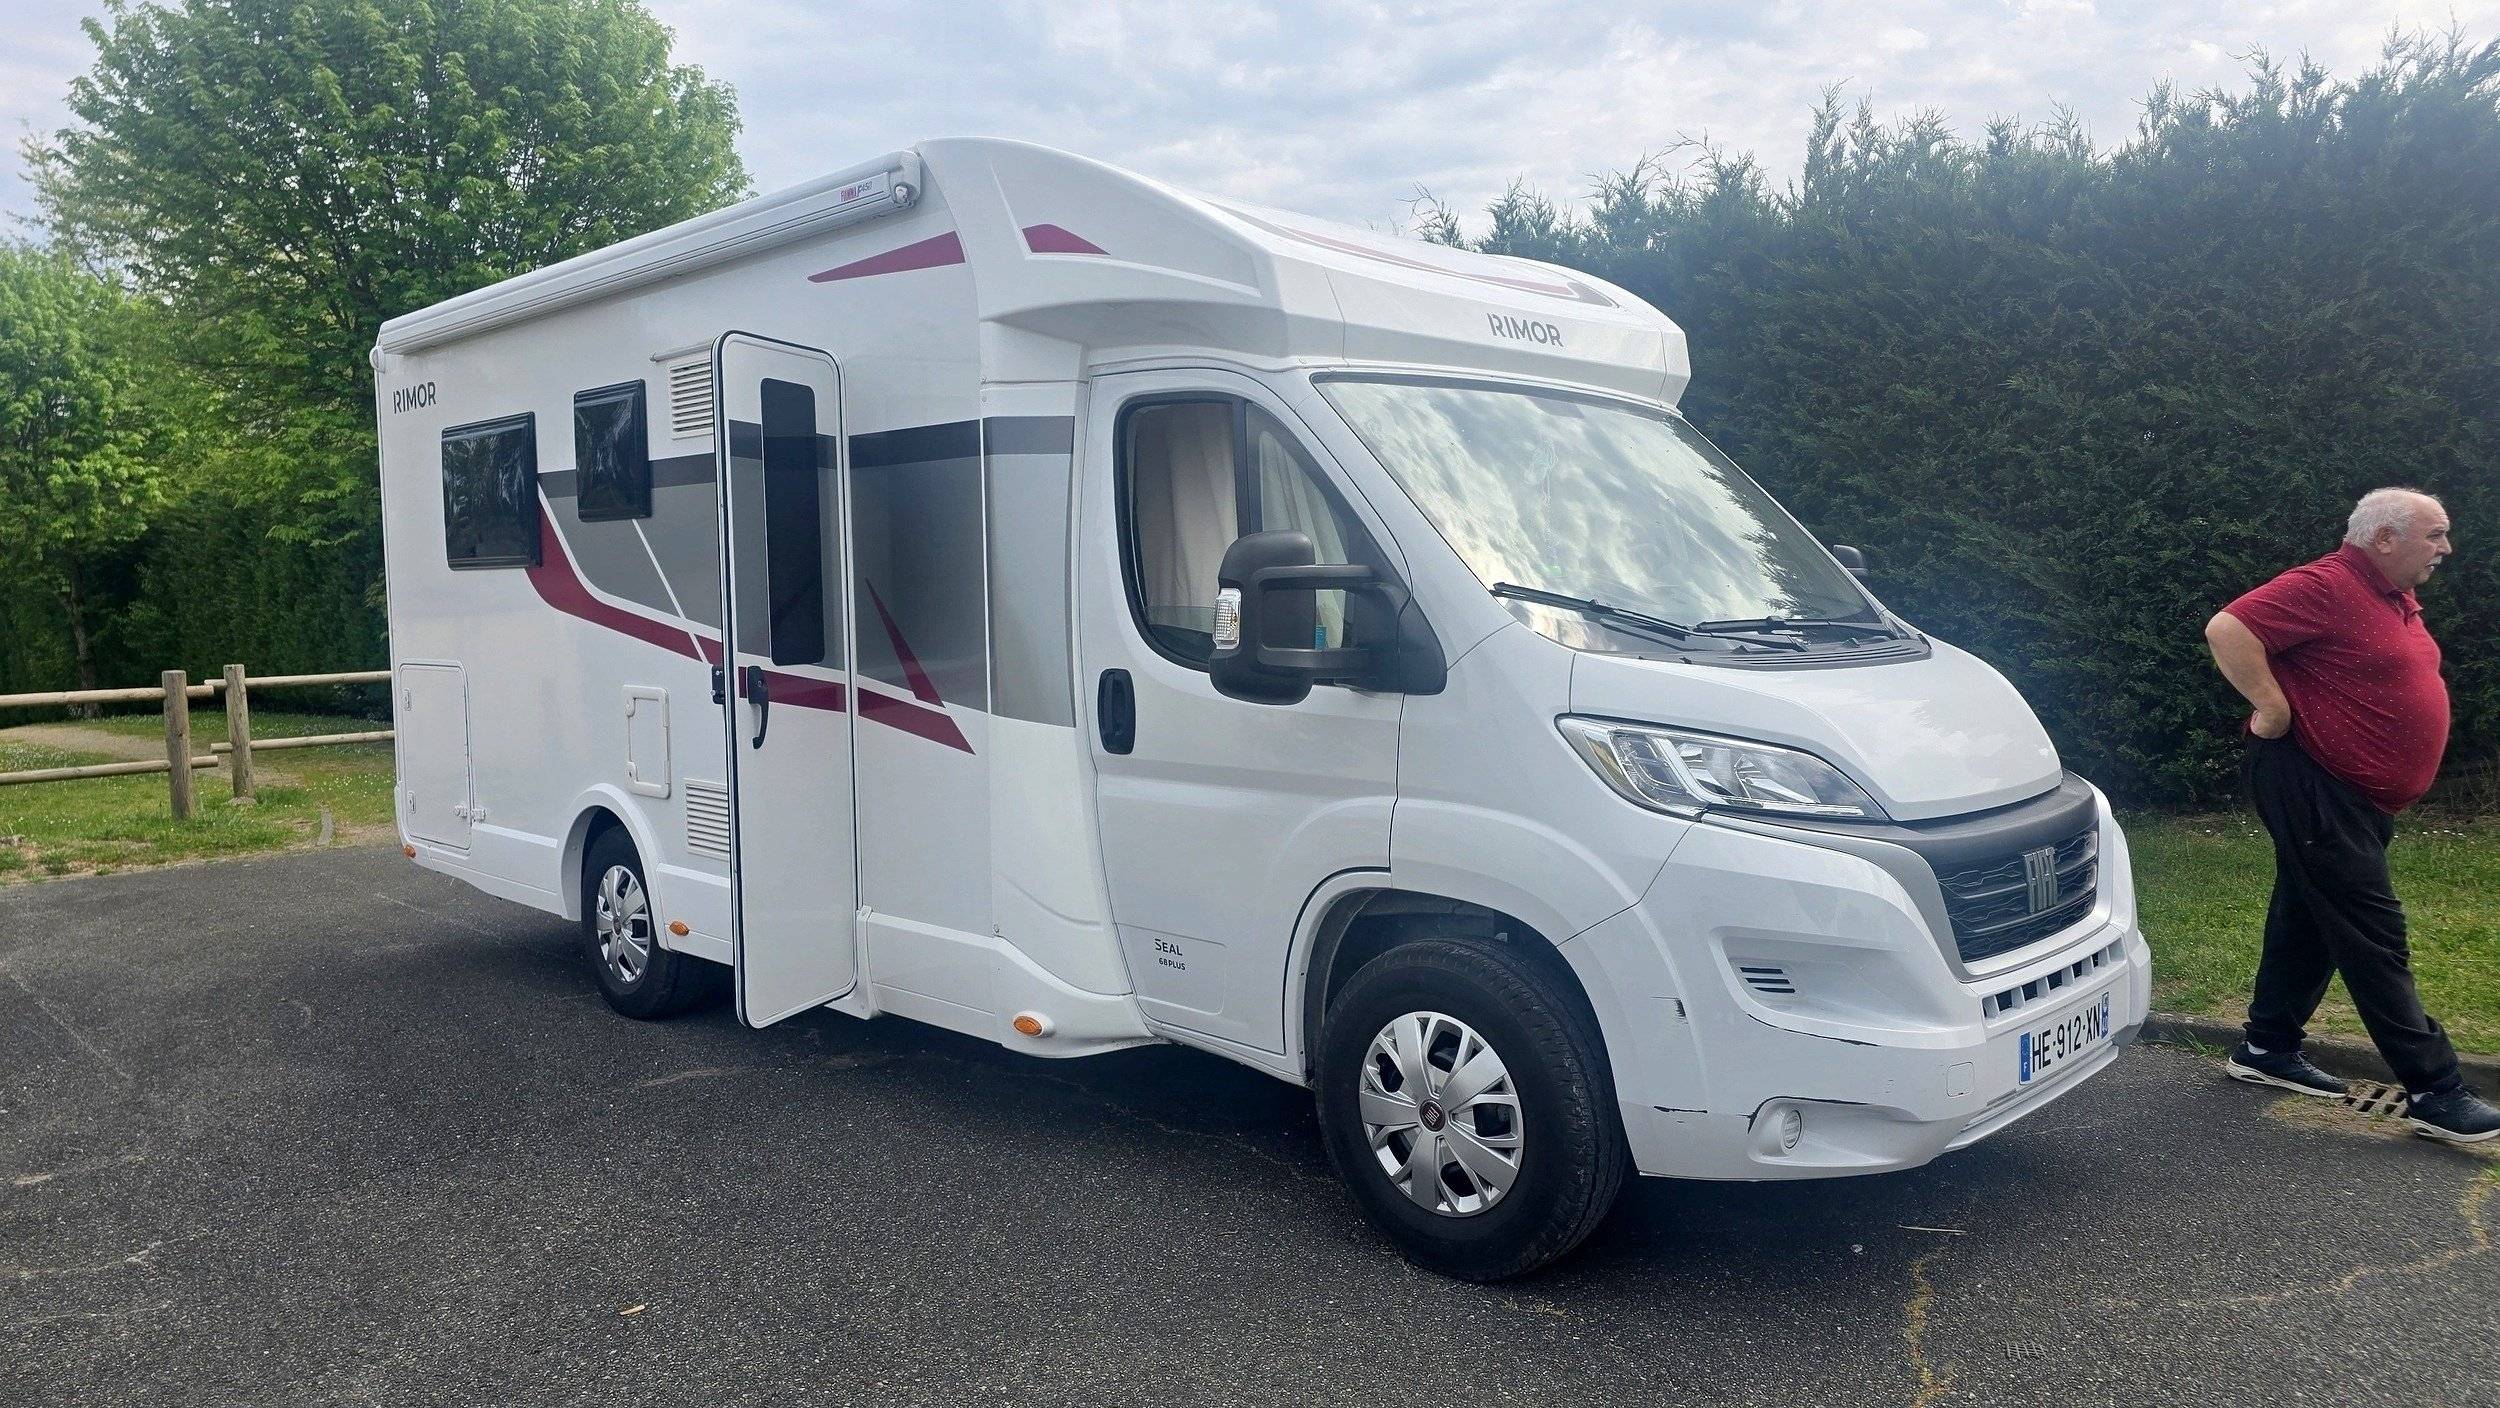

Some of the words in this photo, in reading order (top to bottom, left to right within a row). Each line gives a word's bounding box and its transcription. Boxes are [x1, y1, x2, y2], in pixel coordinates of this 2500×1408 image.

[1486, 313, 1564, 347] RIMOR
[393, 381, 437, 414] RIMOR
[2023, 847, 2058, 913] FIAT
[1154, 938, 1183, 956] SEAL
[2032, 1002, 2100, 1073] HE-912-XN
